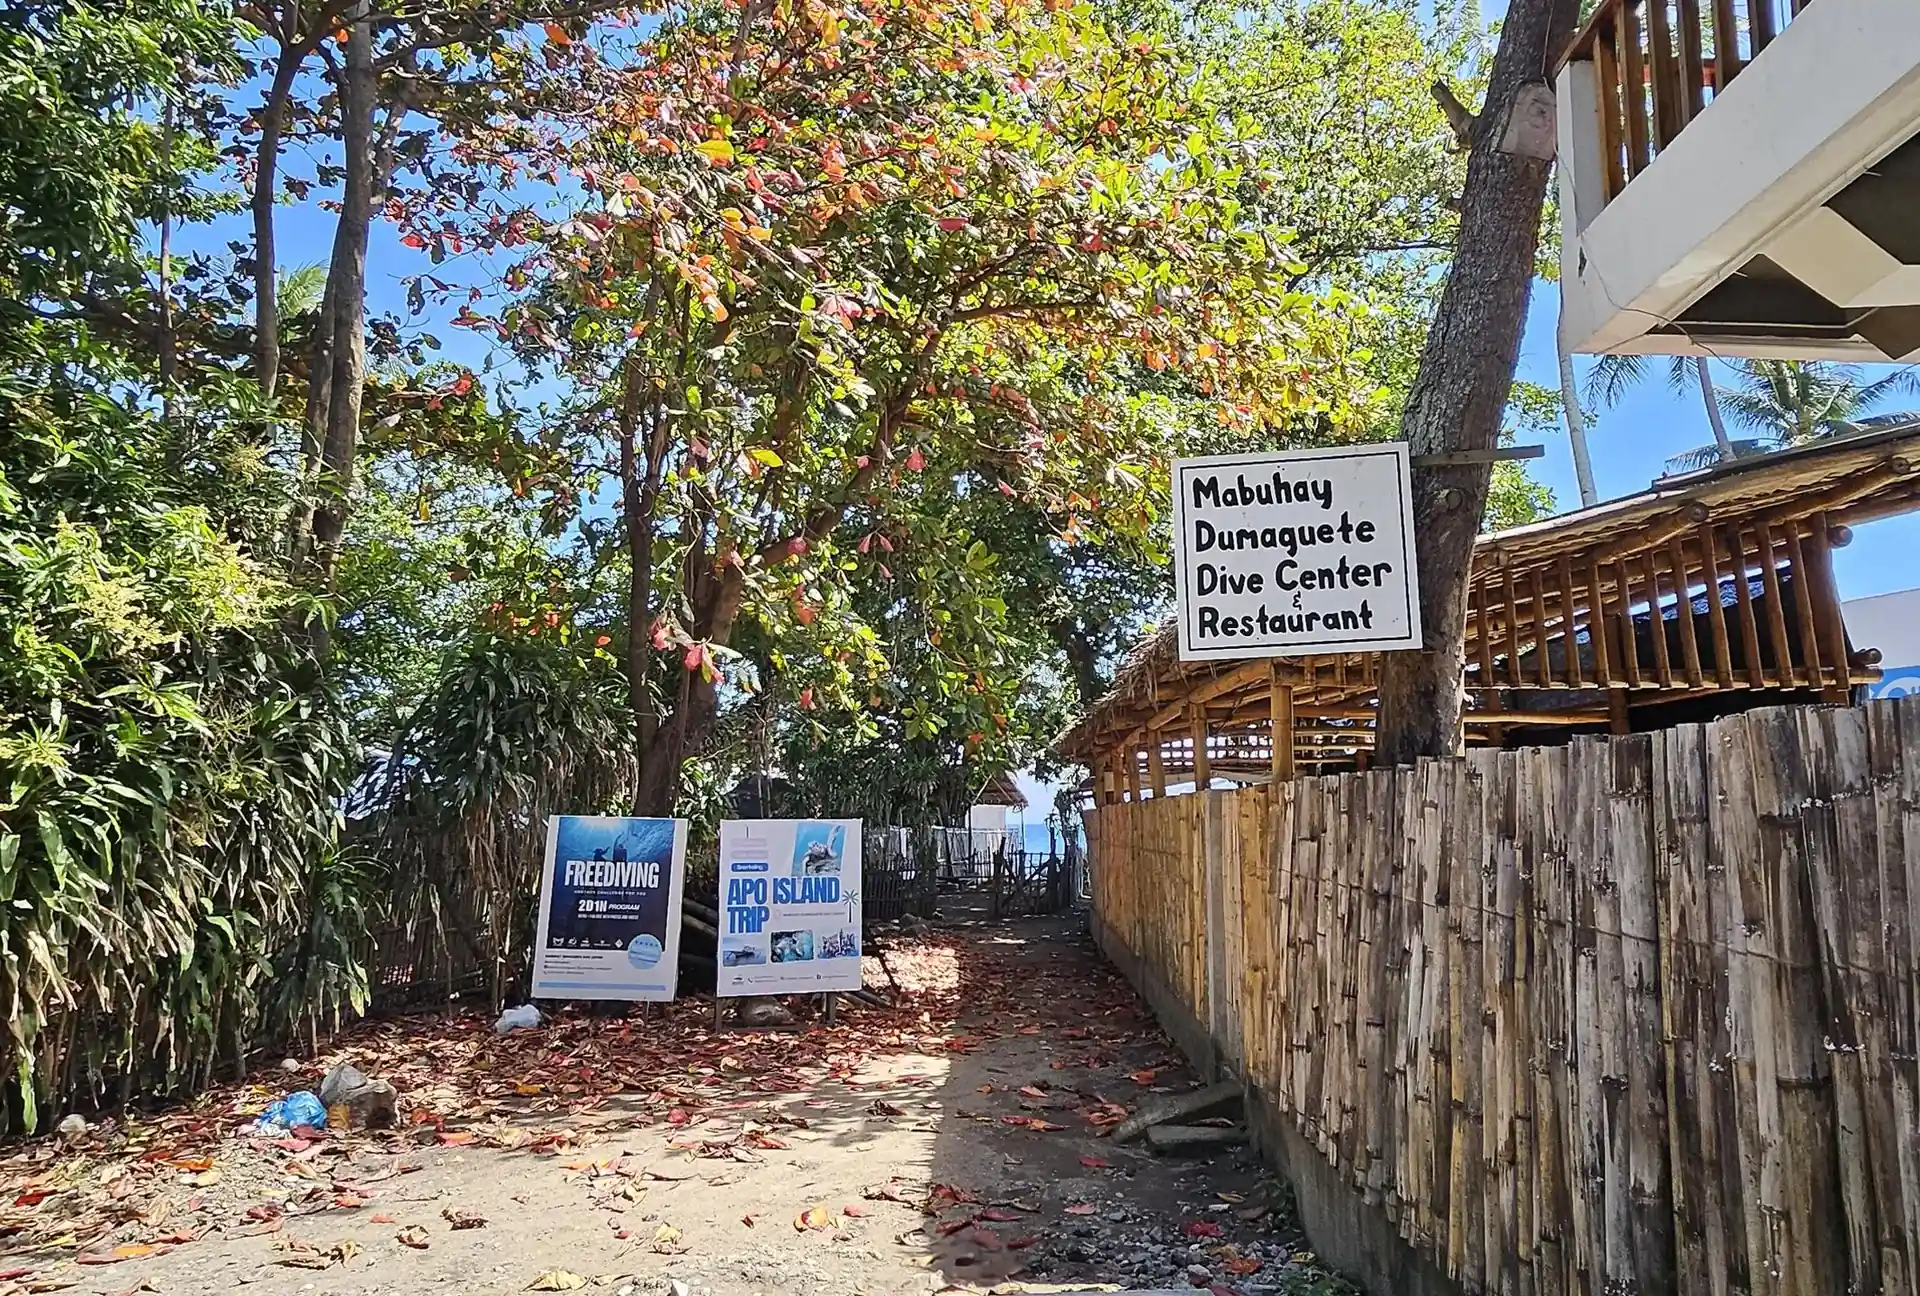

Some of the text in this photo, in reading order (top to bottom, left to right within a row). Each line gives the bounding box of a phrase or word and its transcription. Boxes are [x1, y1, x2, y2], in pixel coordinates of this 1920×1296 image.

[1192, 471, 1332, 509] Mabuhay
[1195, 511, 1376, 557] Dumaguete
[1197, 555, 1392, 596] Dive Center
[1292, 591, 1302, 610] &
[1198, 599, 1373, 638] Restaurant
[564, 860, 660, 889] FREEDIVING
[727, 876, 840, 905] APO ISLAND
[578, 899, 640, 912] 2D1N PROGRAM
[727, 906, 770, 933] TRIP
